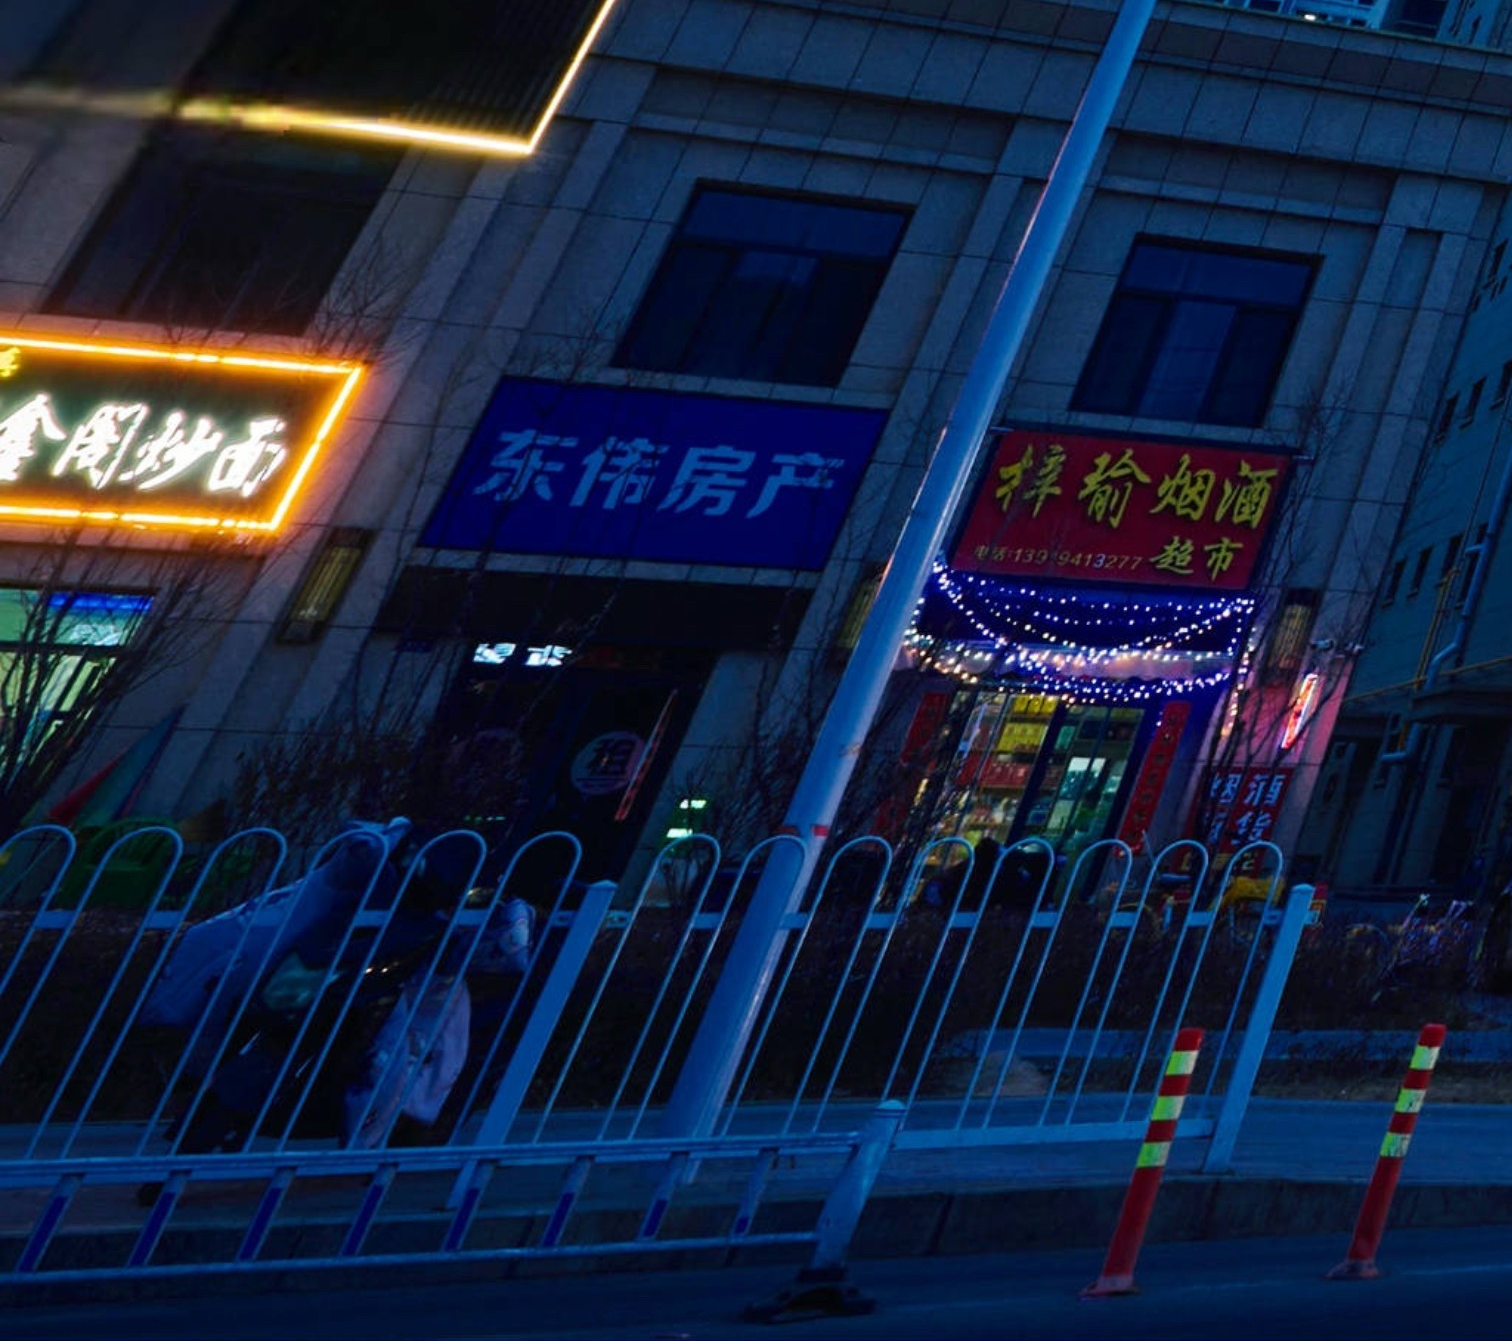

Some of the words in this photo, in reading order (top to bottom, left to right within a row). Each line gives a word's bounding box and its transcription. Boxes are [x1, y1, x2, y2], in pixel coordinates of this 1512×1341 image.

[472, 428, 845, 519] 东伟房产
[1150, 536, 1243, 581] 超市
